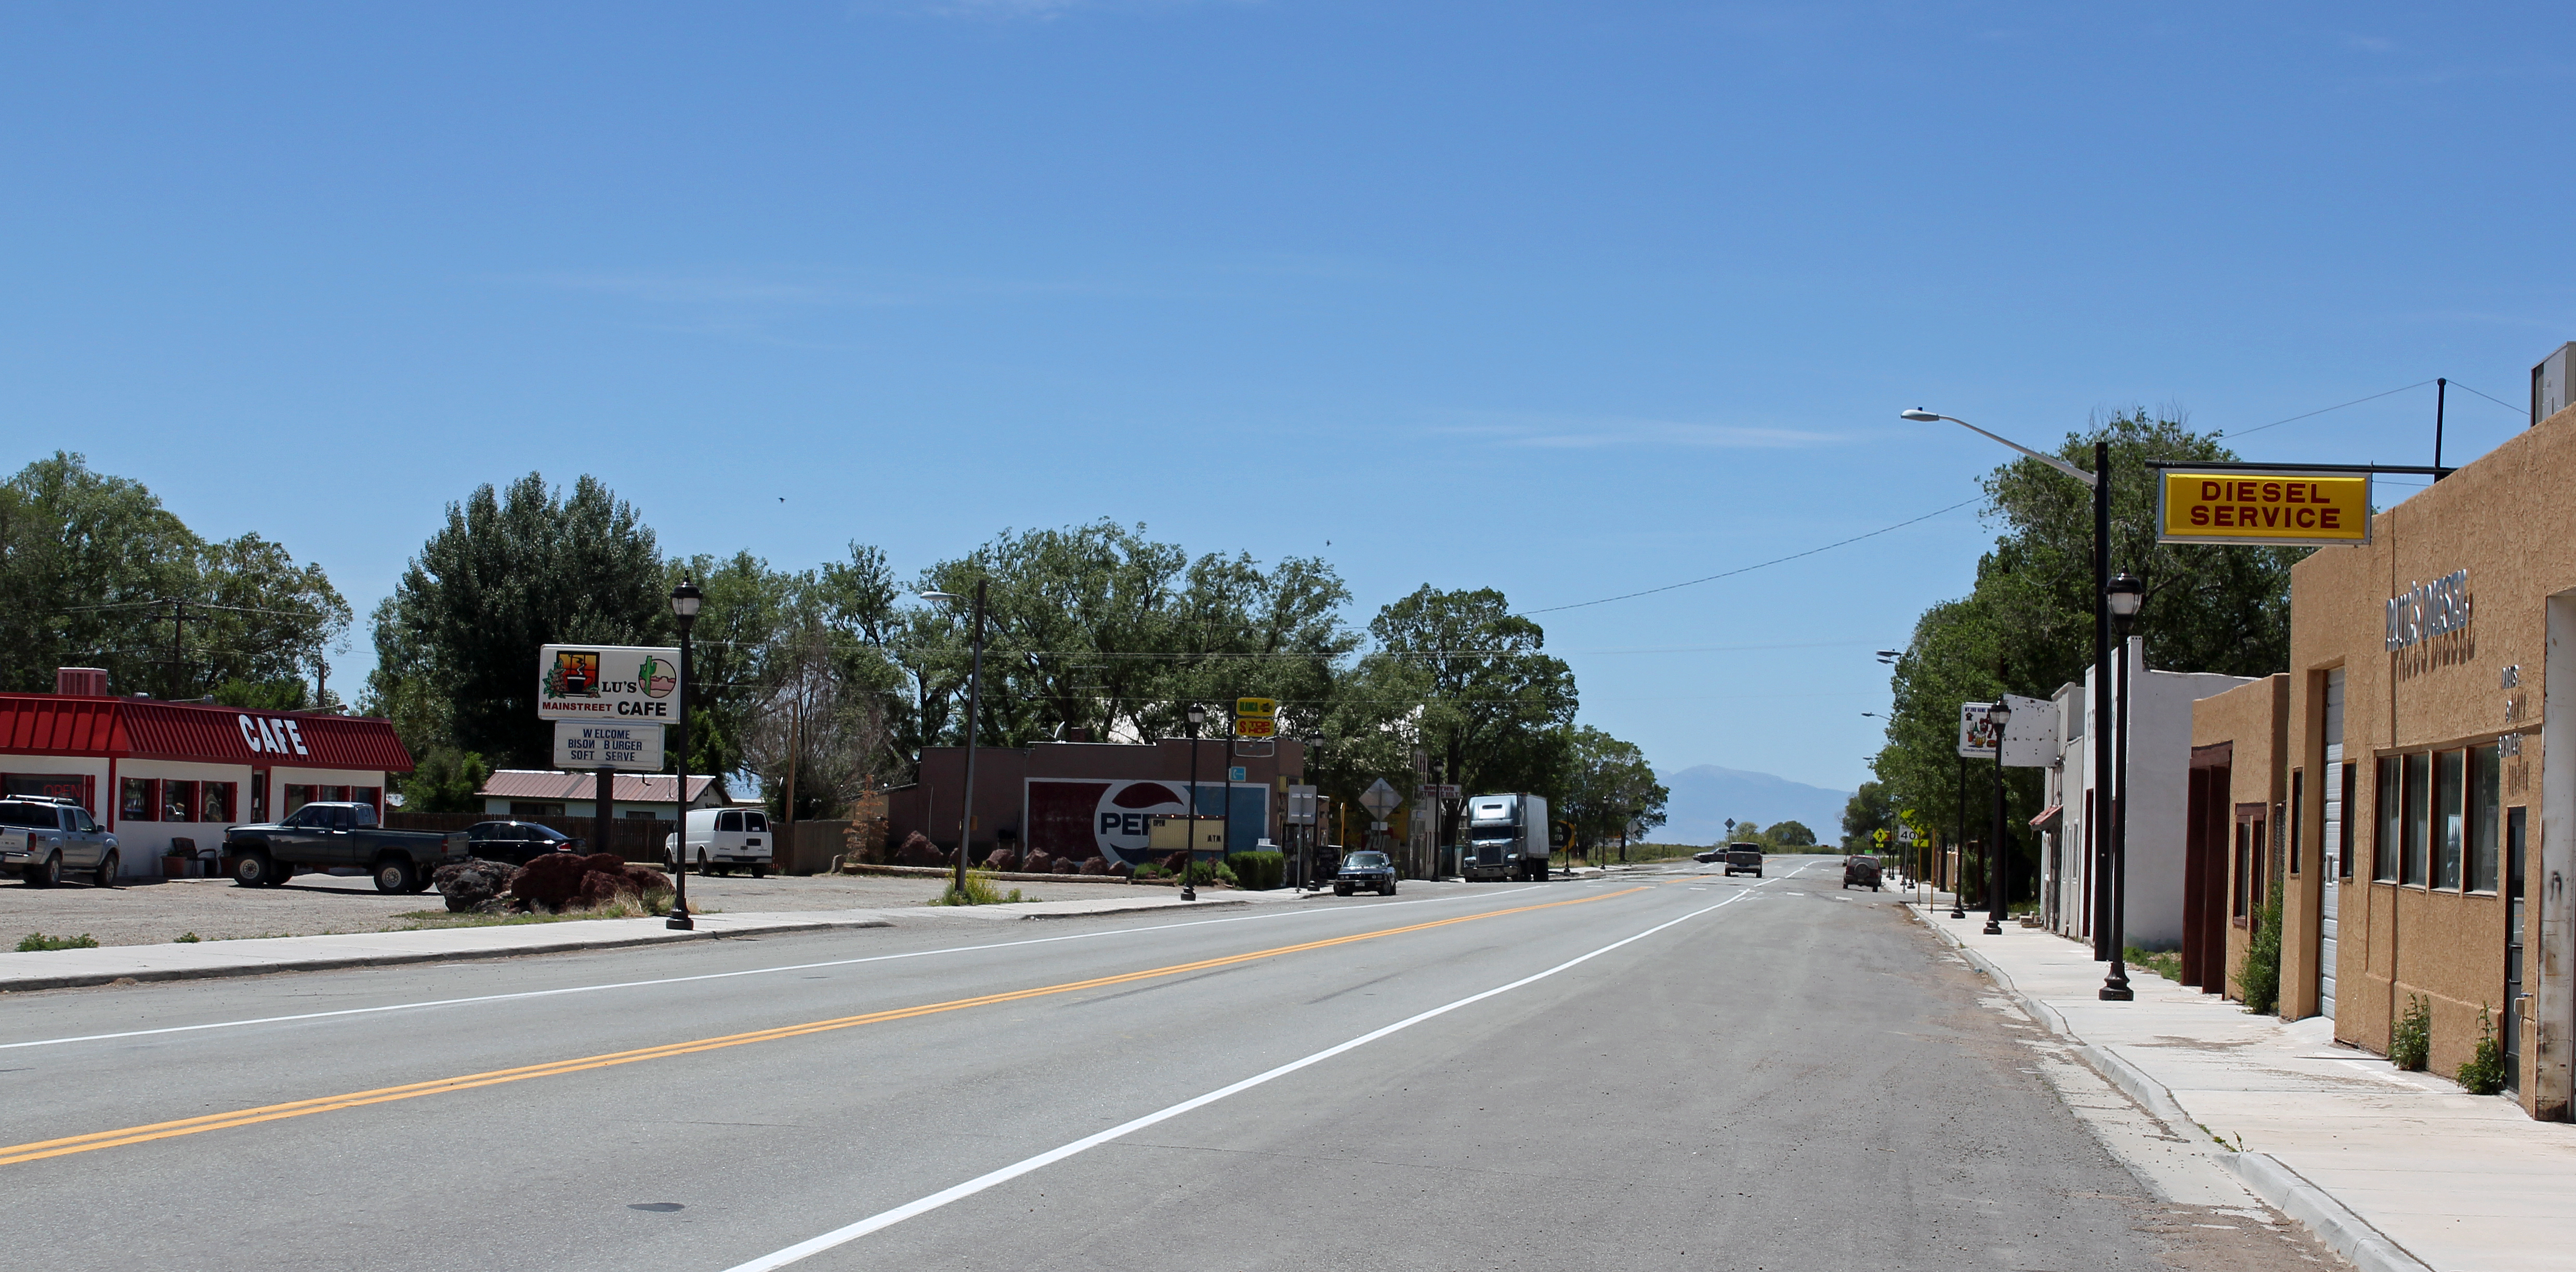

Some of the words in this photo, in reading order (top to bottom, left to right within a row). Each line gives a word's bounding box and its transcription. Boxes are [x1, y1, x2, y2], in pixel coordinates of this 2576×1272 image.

[2201, 481, 2330, 504] DIESEL
[2190, 505, 2341, 529] SERVICE
[2422, 568, 2469, 642] DIESEL
[601, 681, 637, 693] LU'S
[542, 702, 613, 712] MAINSTREET
[617, 701, 667, 717] CAFE
[239, 714, 309, 755] CAFE
[568, 739, 595, 749] BISON
[603, 740, 642, 751] BURGER
[571, 750, 595, 760] SOFT
[605, 751, 635, 761] SERVE
[43, 784, 82, 798] OPEN
[1900, 831, 1916, 840] 40
